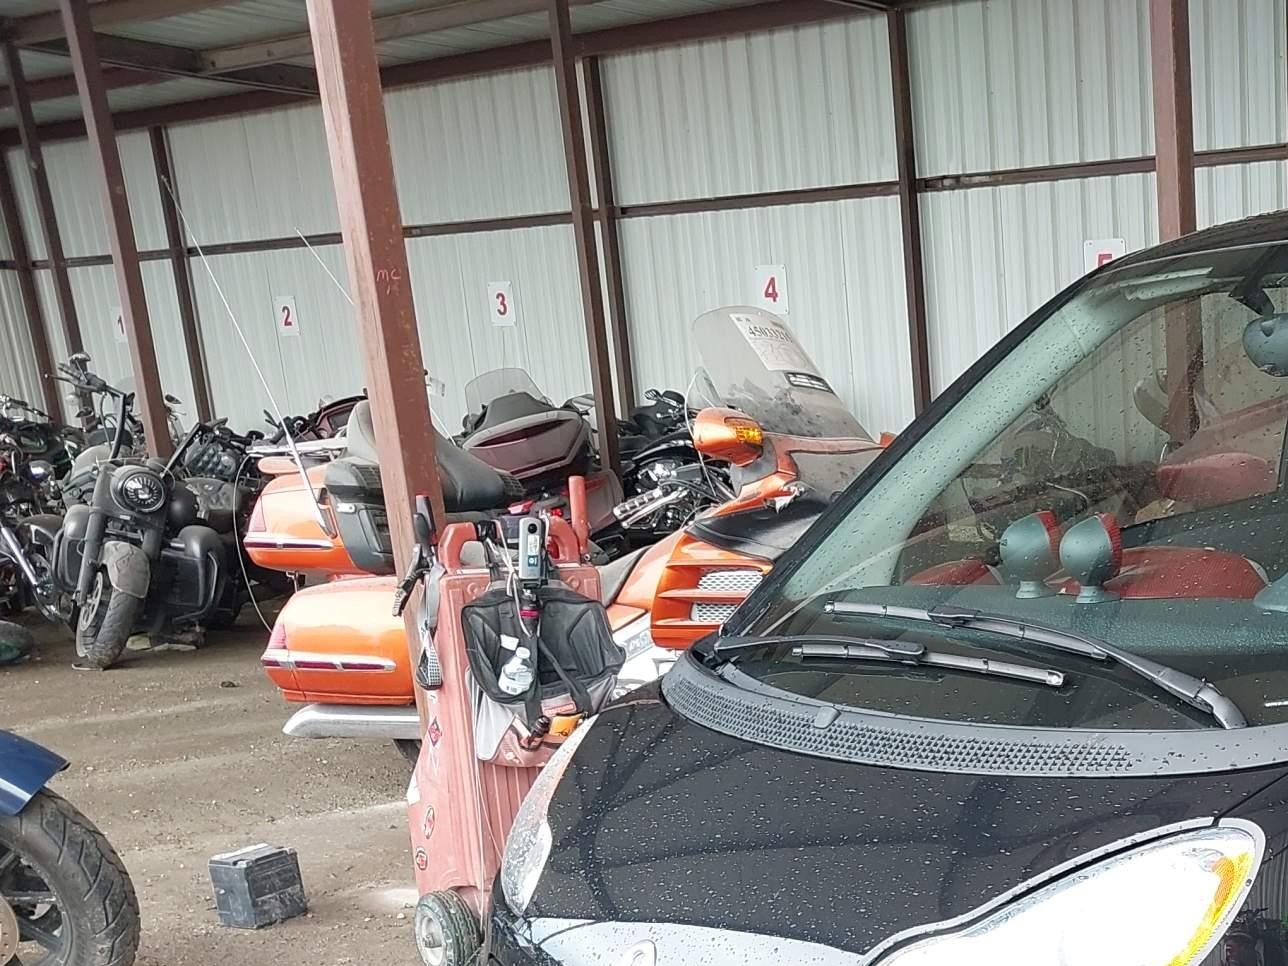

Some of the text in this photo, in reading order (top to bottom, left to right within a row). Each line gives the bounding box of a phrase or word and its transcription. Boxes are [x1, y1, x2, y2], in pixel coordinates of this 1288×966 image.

[764, 276, 779, 303] 4
[281, 305, 293, 327] 2
[495, 292, 508, 316] 3
